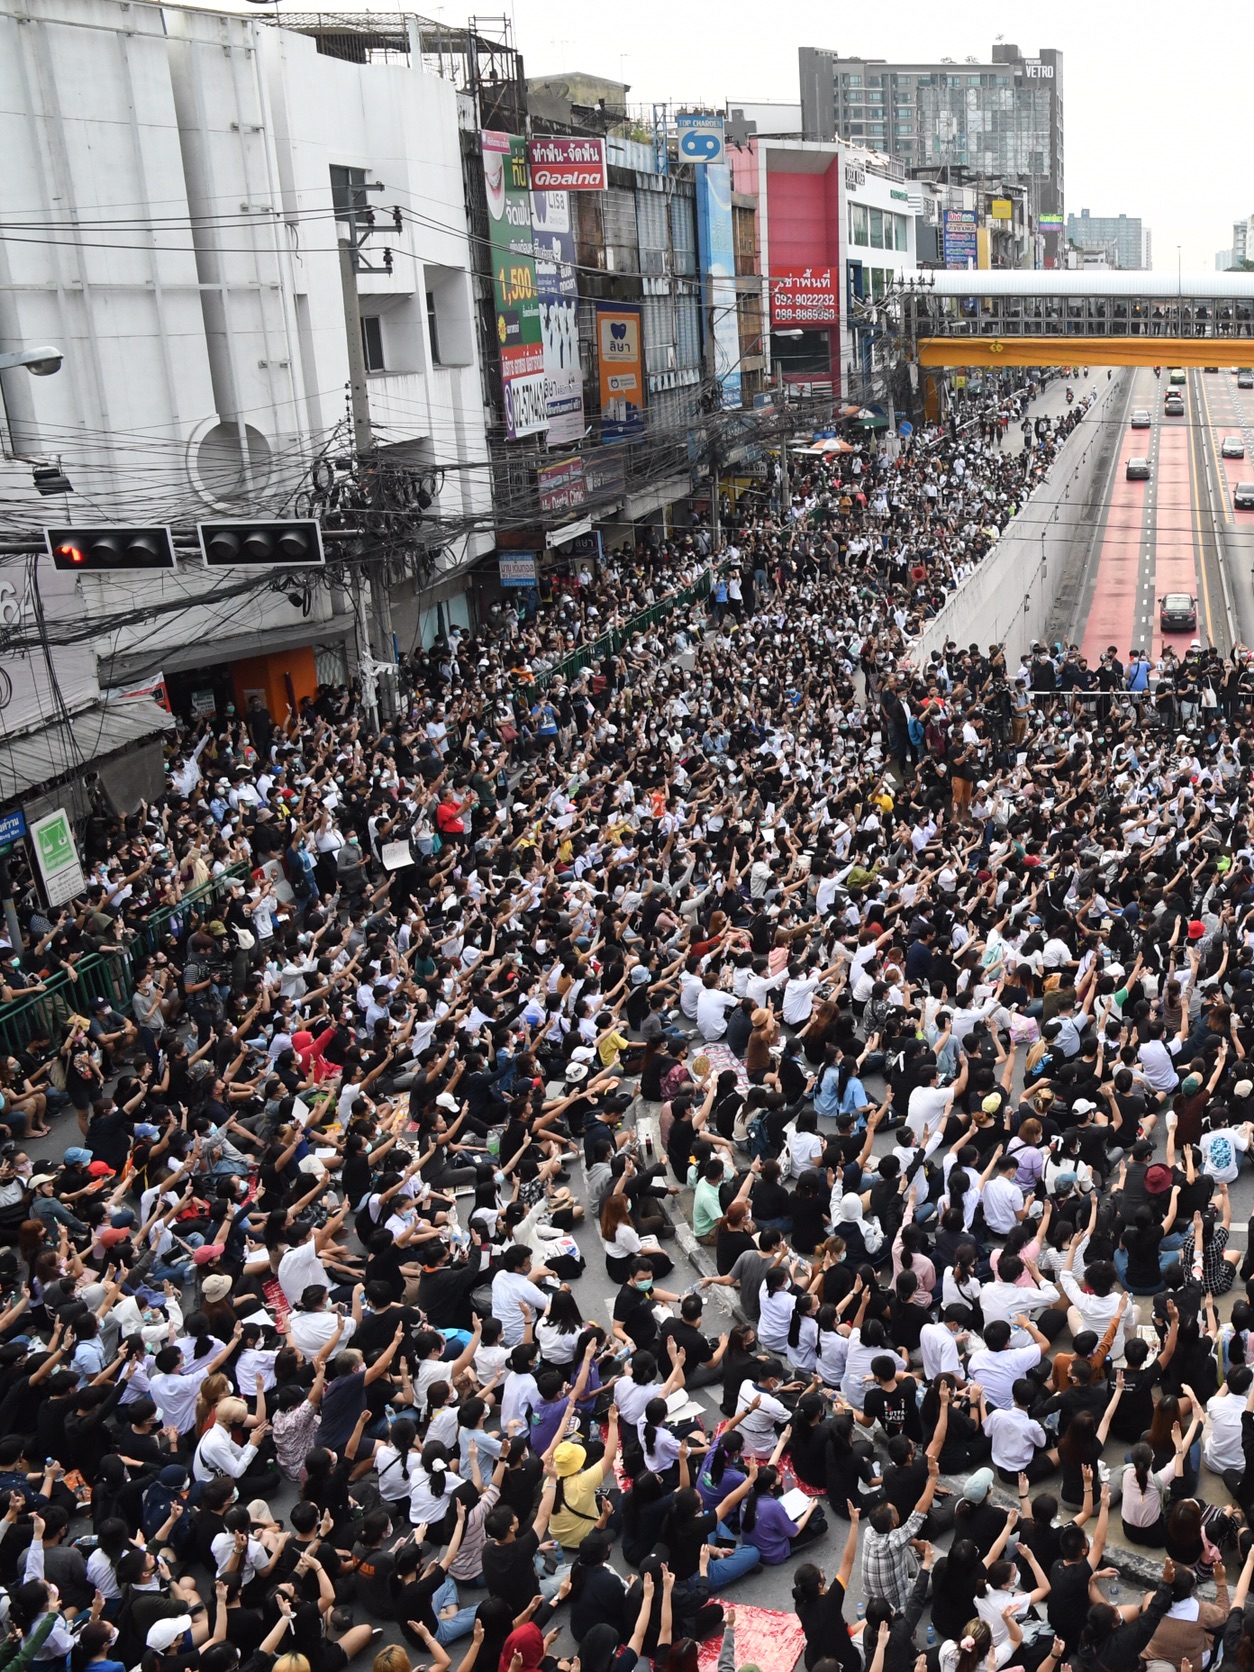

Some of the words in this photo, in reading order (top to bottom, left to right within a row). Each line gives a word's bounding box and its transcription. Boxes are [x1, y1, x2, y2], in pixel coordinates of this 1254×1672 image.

[1025, 65, 1054, 78] VETRO
[679, 119, 692, 127] TOP
[532, 142, 600, 163] ทำฟัน-จัดฟัน
[534, 170, 601, 186] คอลเกต
[499, 266, 532, 307] 1,500
[774, 293, 835, 306] 092-9022232
[609, 341, 631, 352] ลิษา
